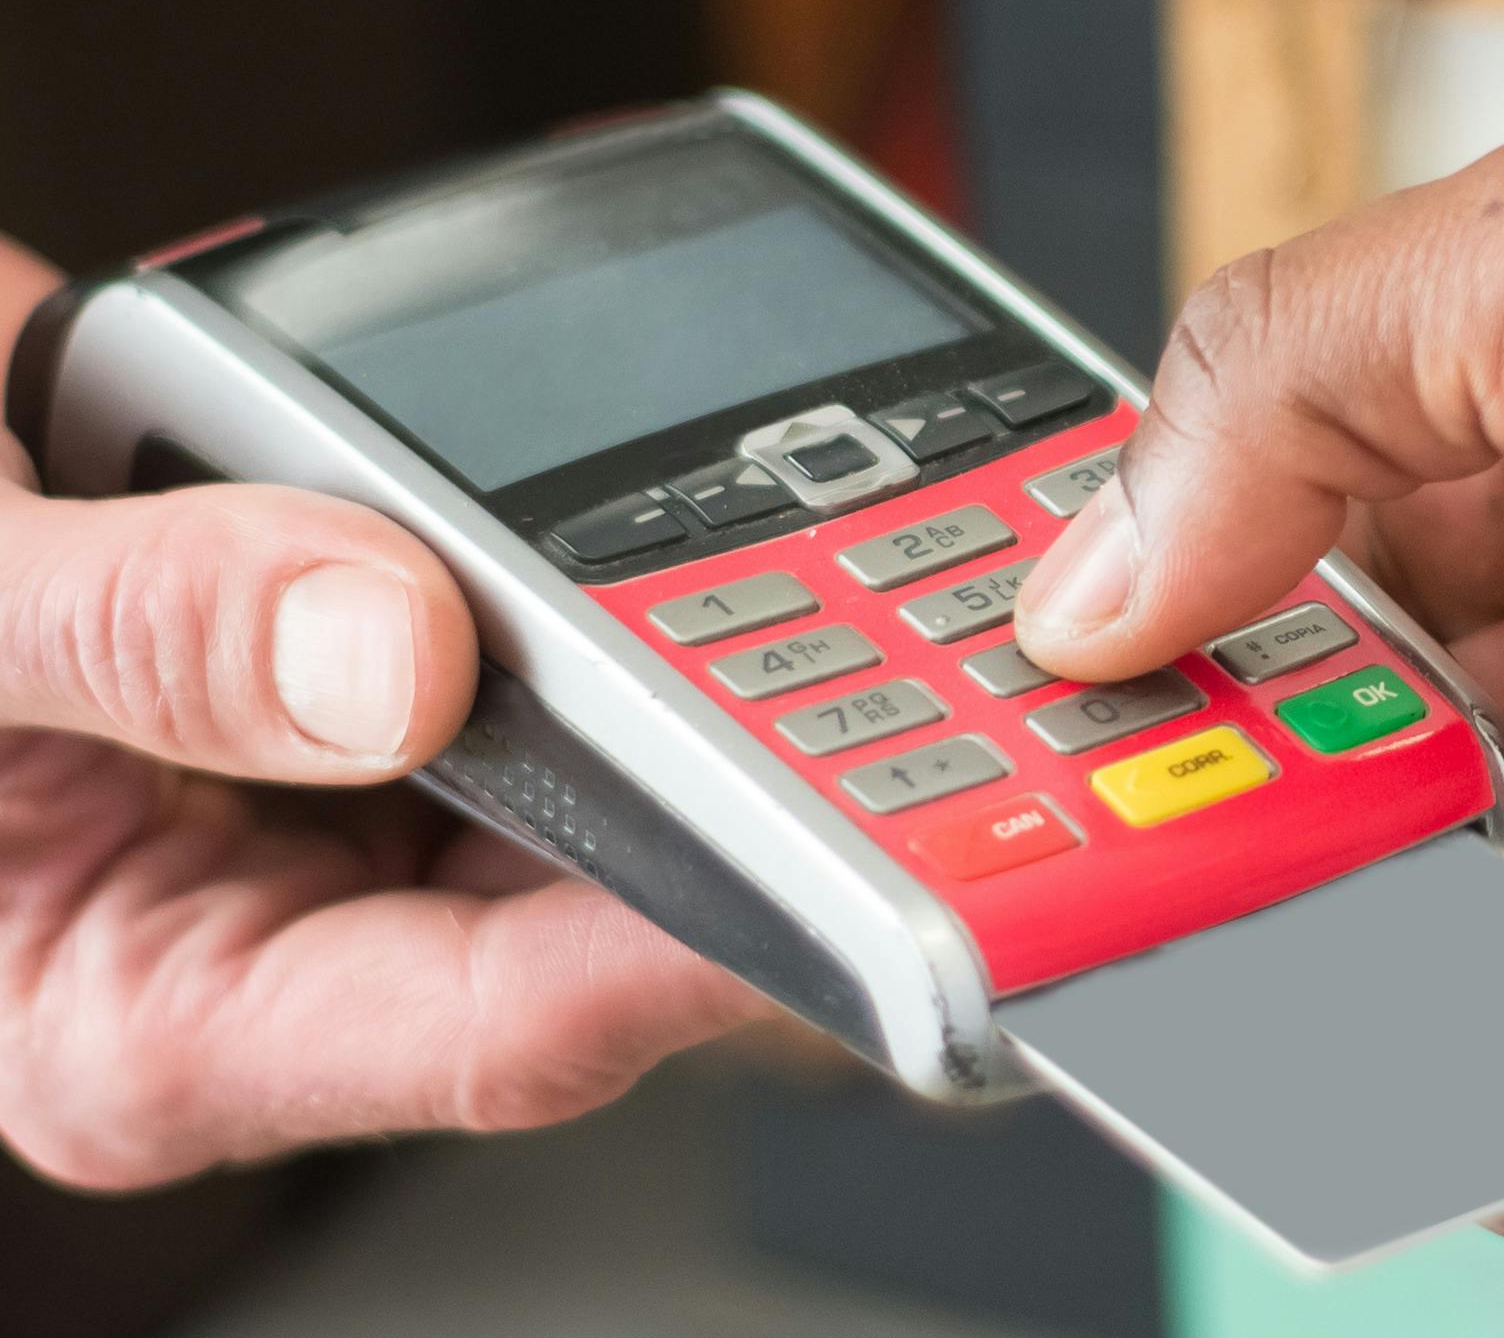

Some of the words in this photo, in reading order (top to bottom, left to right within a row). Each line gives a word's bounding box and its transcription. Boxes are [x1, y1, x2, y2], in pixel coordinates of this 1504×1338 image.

[892, 533, 935, 560] 2
[702, 593, 735, 617] 1
[952, 585, 993, 611] 5
[1274, 624, 1327, 645] COPIA
[763, 650, 794, 674] 4
[1352, 680, 1399, 708] OK
[817, 706, 849, 734] 7
[991, 810, 1045, 839] CAN
